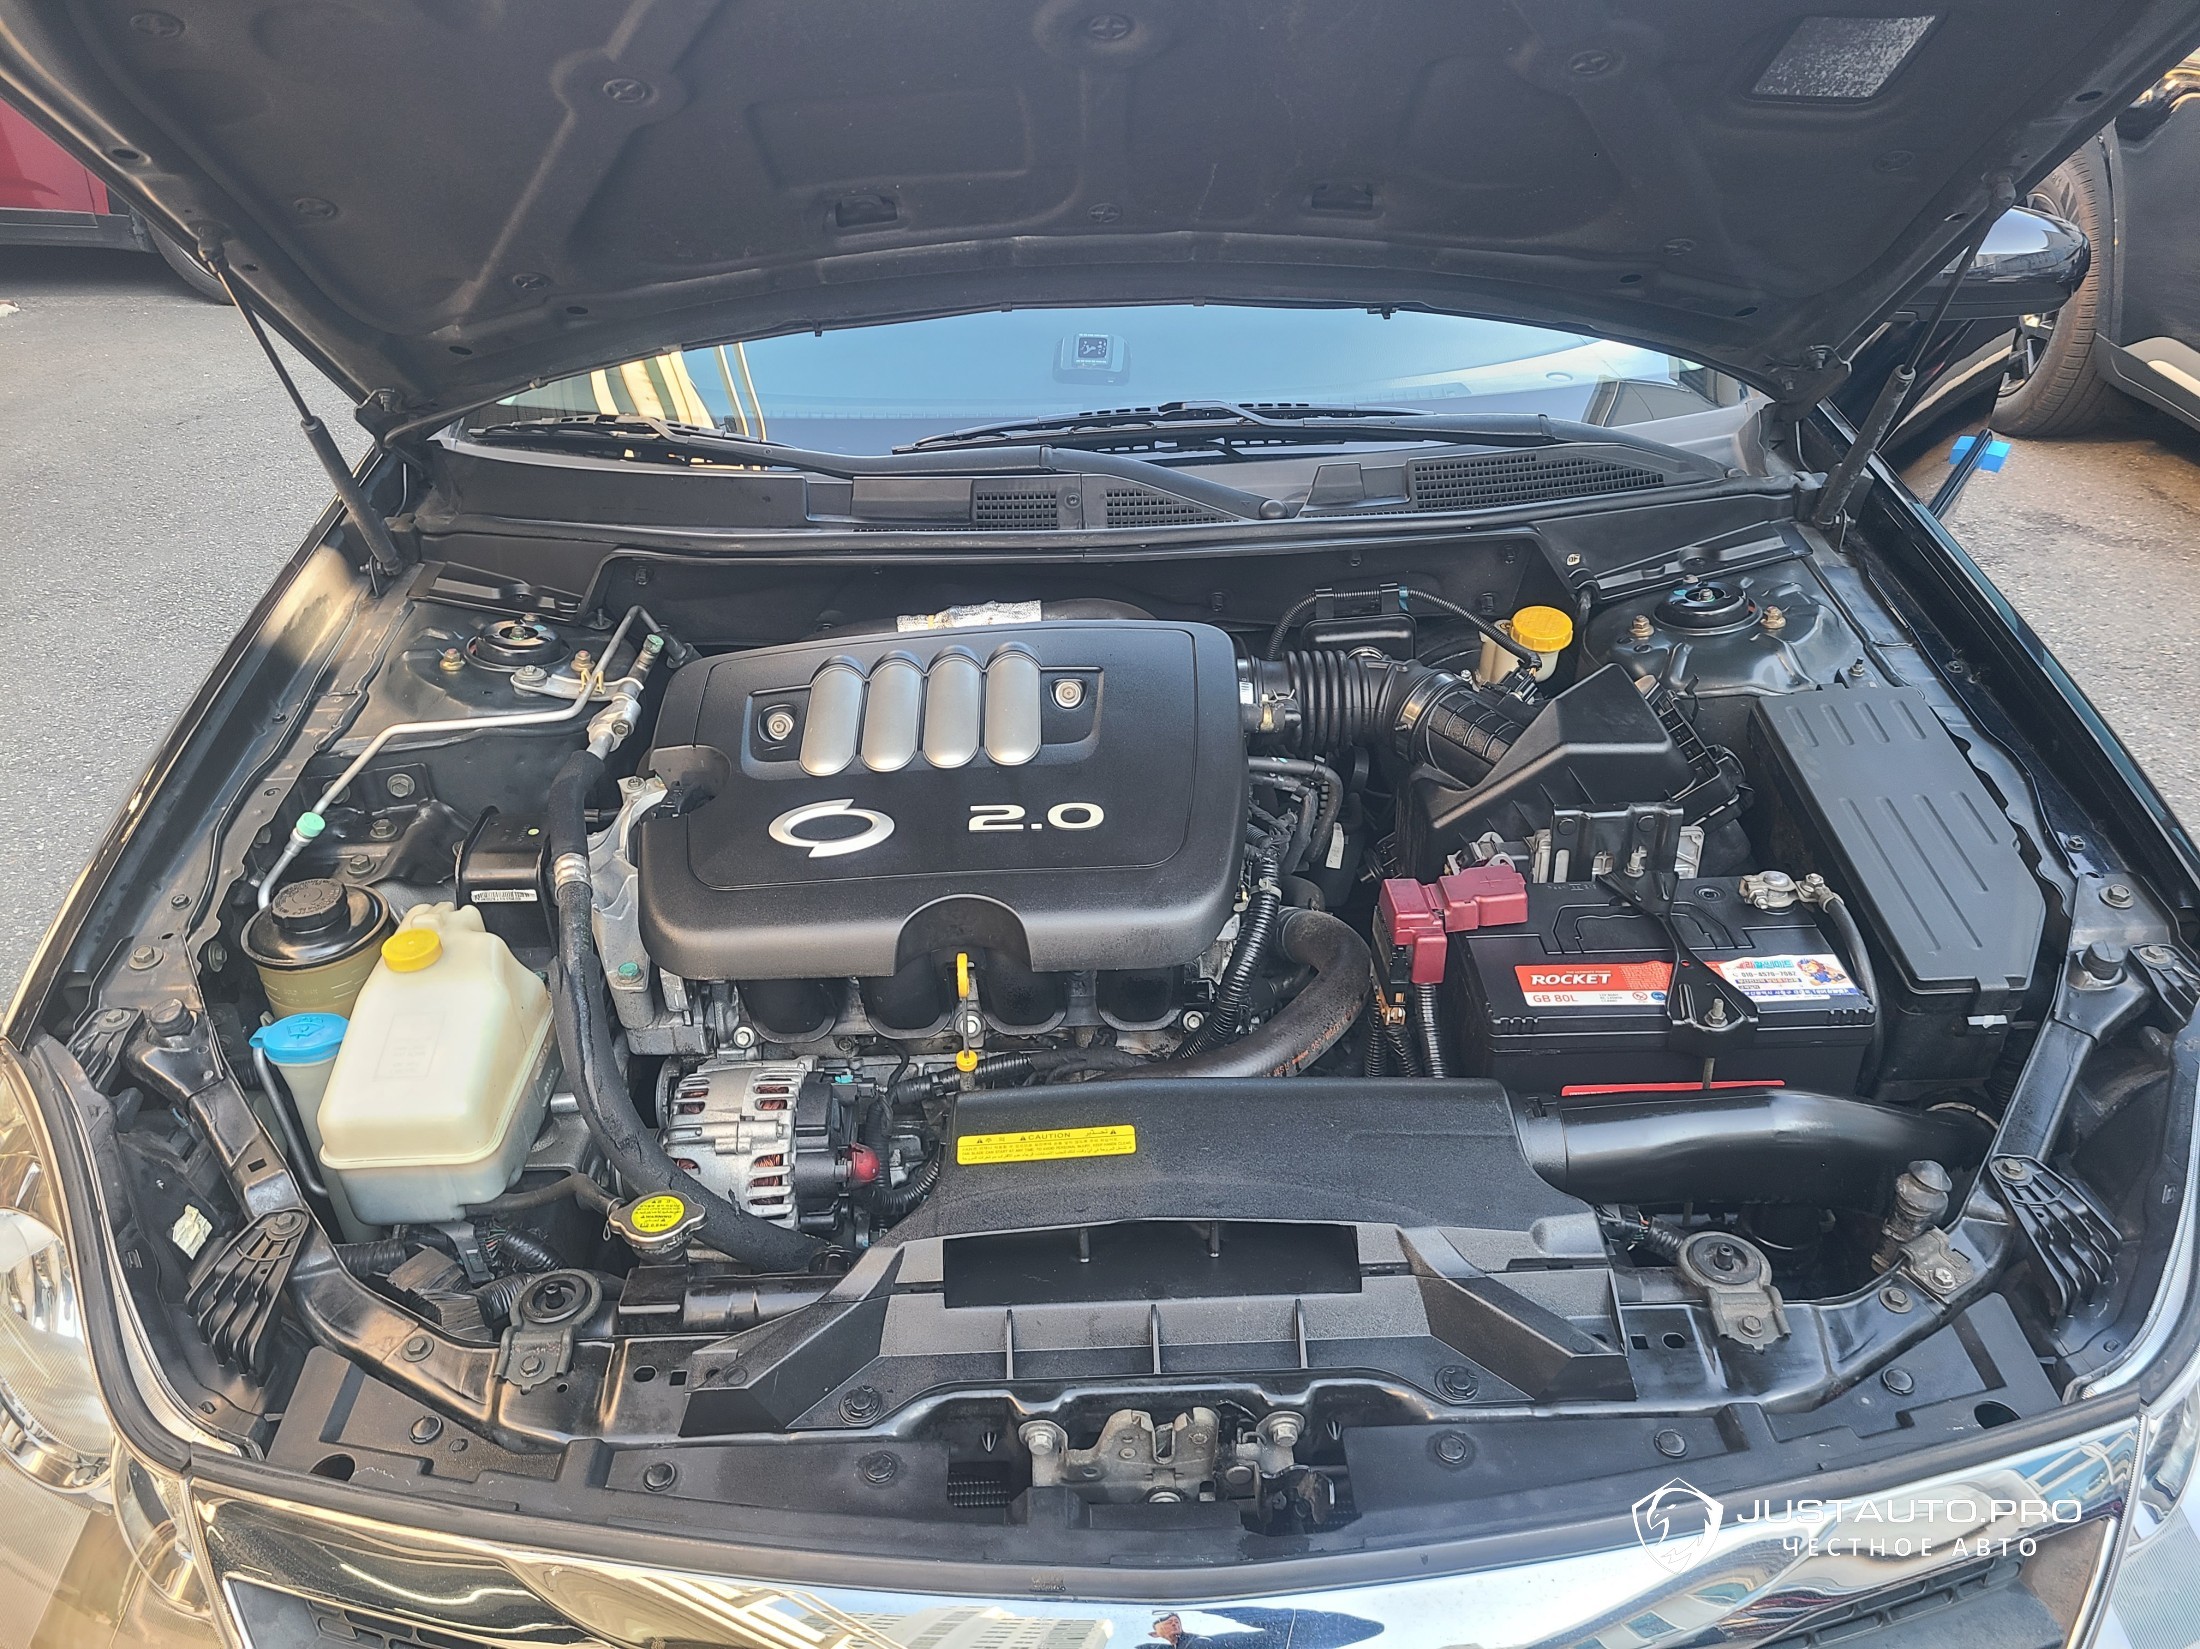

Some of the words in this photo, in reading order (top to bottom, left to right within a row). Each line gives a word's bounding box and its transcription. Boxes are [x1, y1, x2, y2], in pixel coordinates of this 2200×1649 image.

[968, 802, 1105, 831] 2.0
[1530, 973, 1612, 985] ROCKET
[1533, 994, 1551, 1003] GB
[1554, 993, 1579, 1003] 80L
[1028, 1132, 1071, 1141] CAUTION
